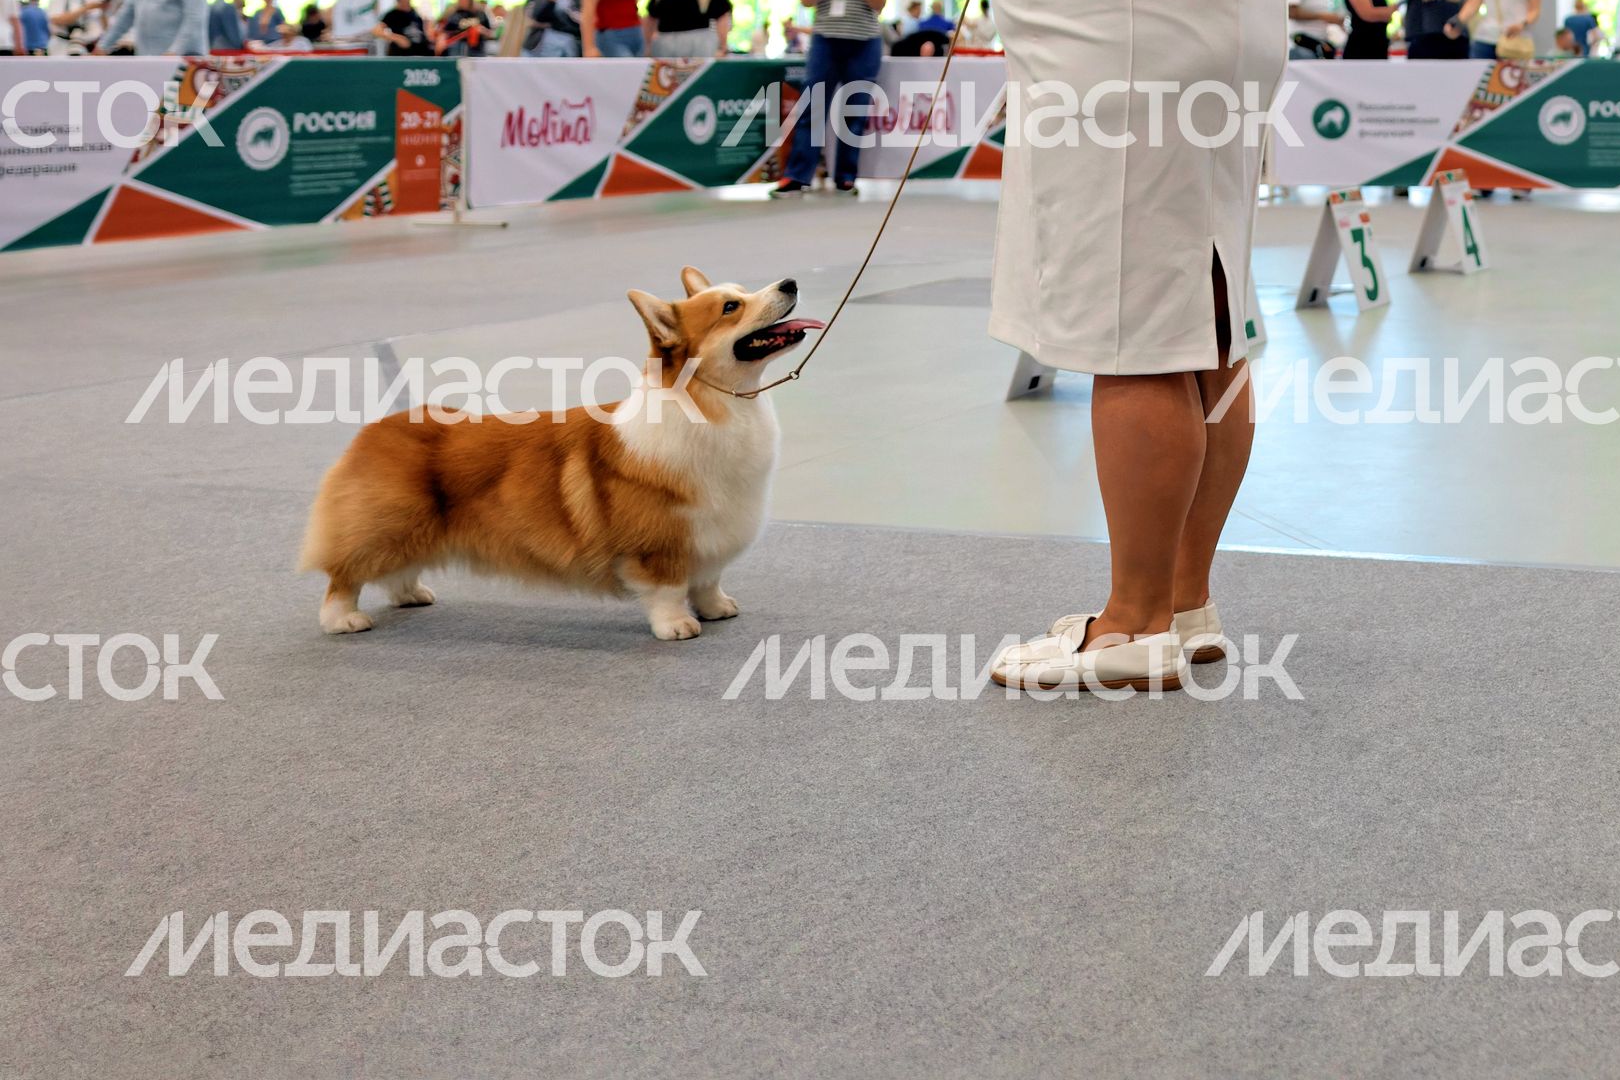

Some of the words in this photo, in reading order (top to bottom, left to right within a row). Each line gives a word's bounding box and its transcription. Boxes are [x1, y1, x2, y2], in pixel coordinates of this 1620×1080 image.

[403, 69, 441, 86] 2026
[292, 110, 376, 133] РОССИЯ
[501, 97, 596, 149] Molina
[1461, 204, 1482, 267] 4
